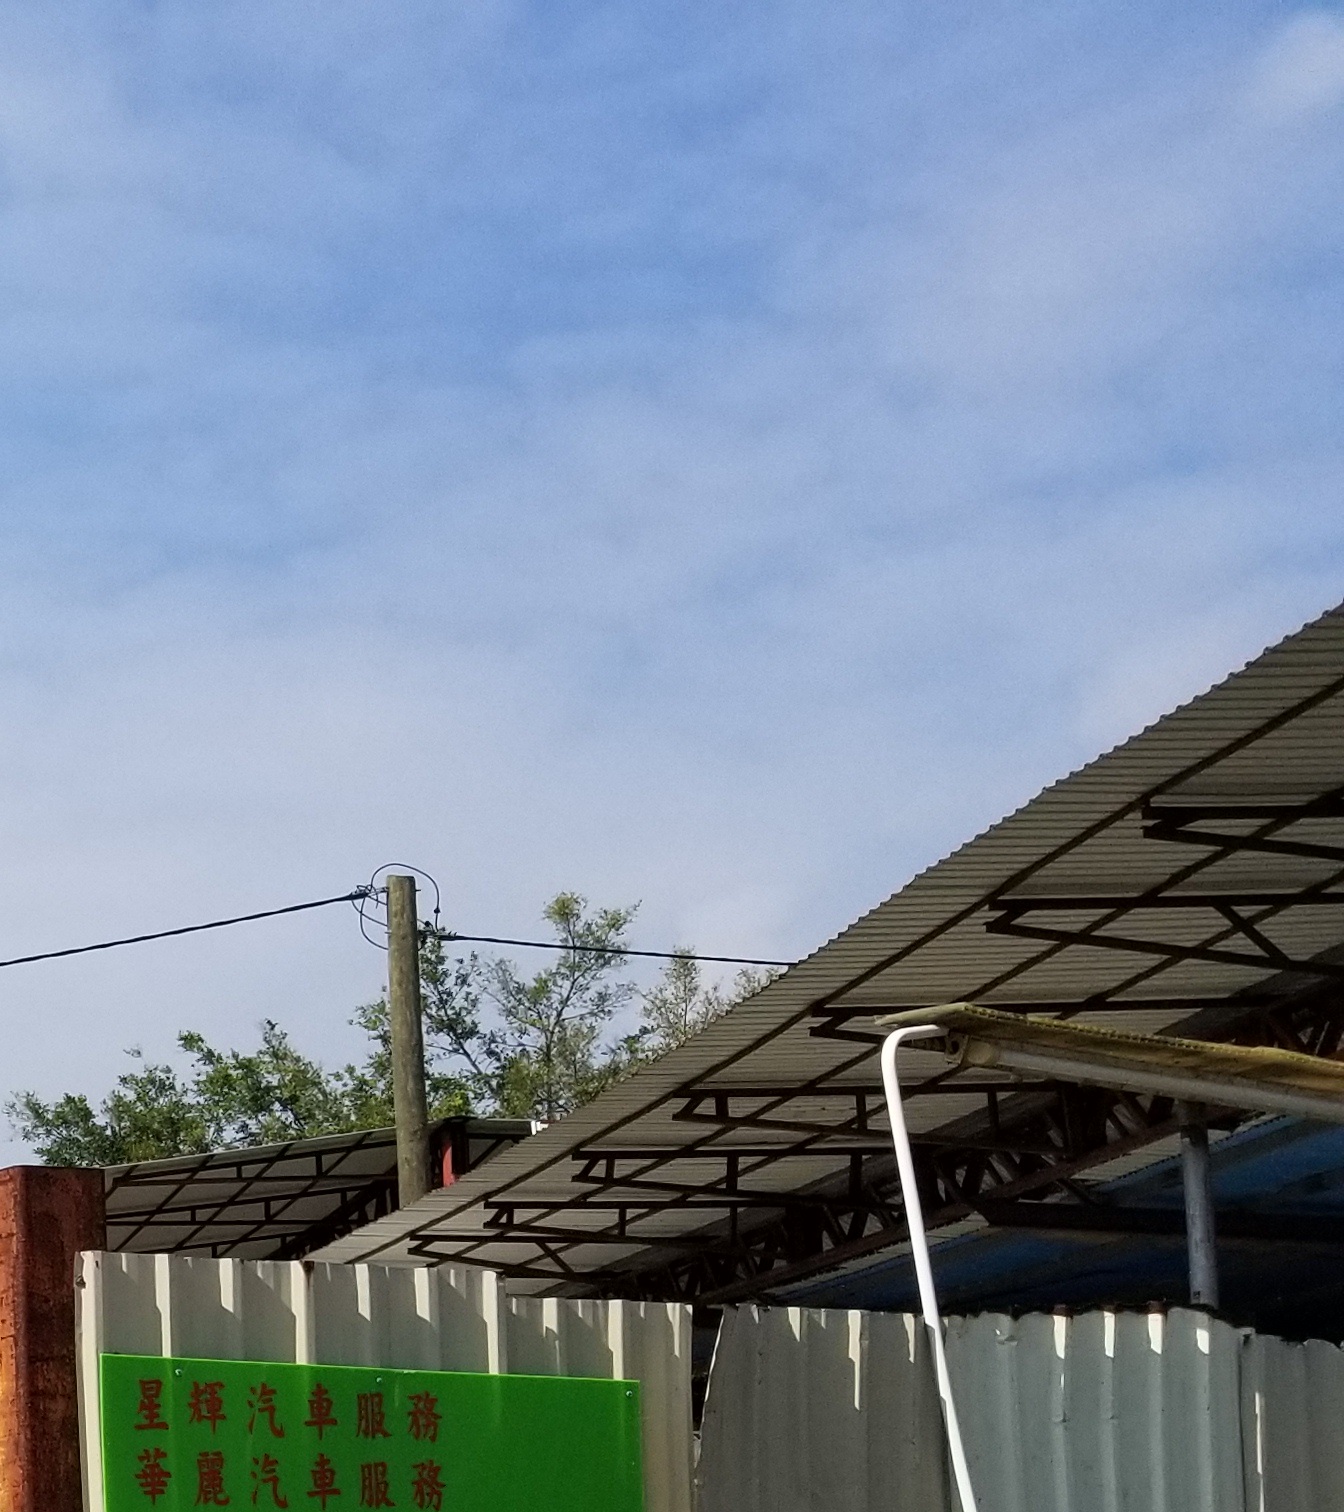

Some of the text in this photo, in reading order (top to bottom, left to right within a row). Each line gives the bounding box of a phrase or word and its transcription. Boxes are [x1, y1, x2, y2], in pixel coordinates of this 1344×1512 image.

[134, 1379, 442, 1442] 星輝汽車服務
[134, 1448, 446, 1512] 華麗汽車服務
